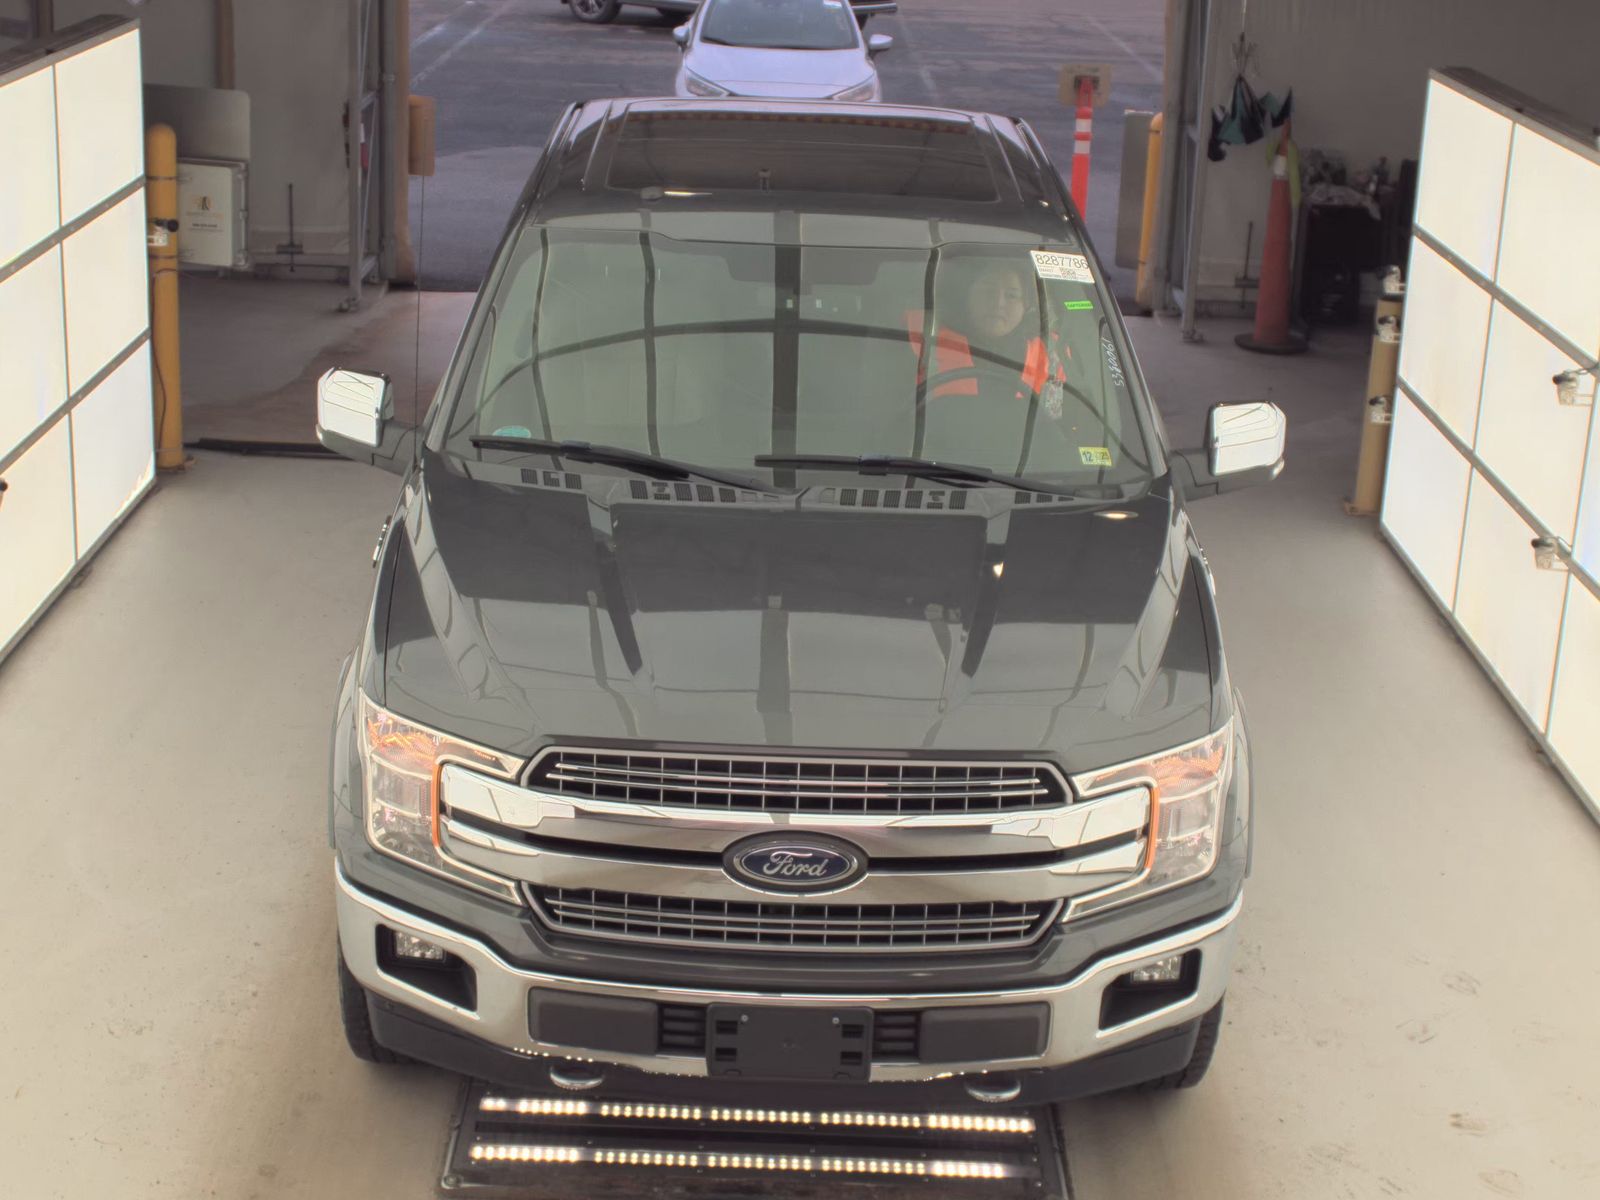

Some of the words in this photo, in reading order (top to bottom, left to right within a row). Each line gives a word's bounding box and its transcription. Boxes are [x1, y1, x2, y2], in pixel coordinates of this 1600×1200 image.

[1035, 253, 1089, 270] 8287786
[1082, 450, 1094, 462] 12
[763, 850, 829, 876] Ford
